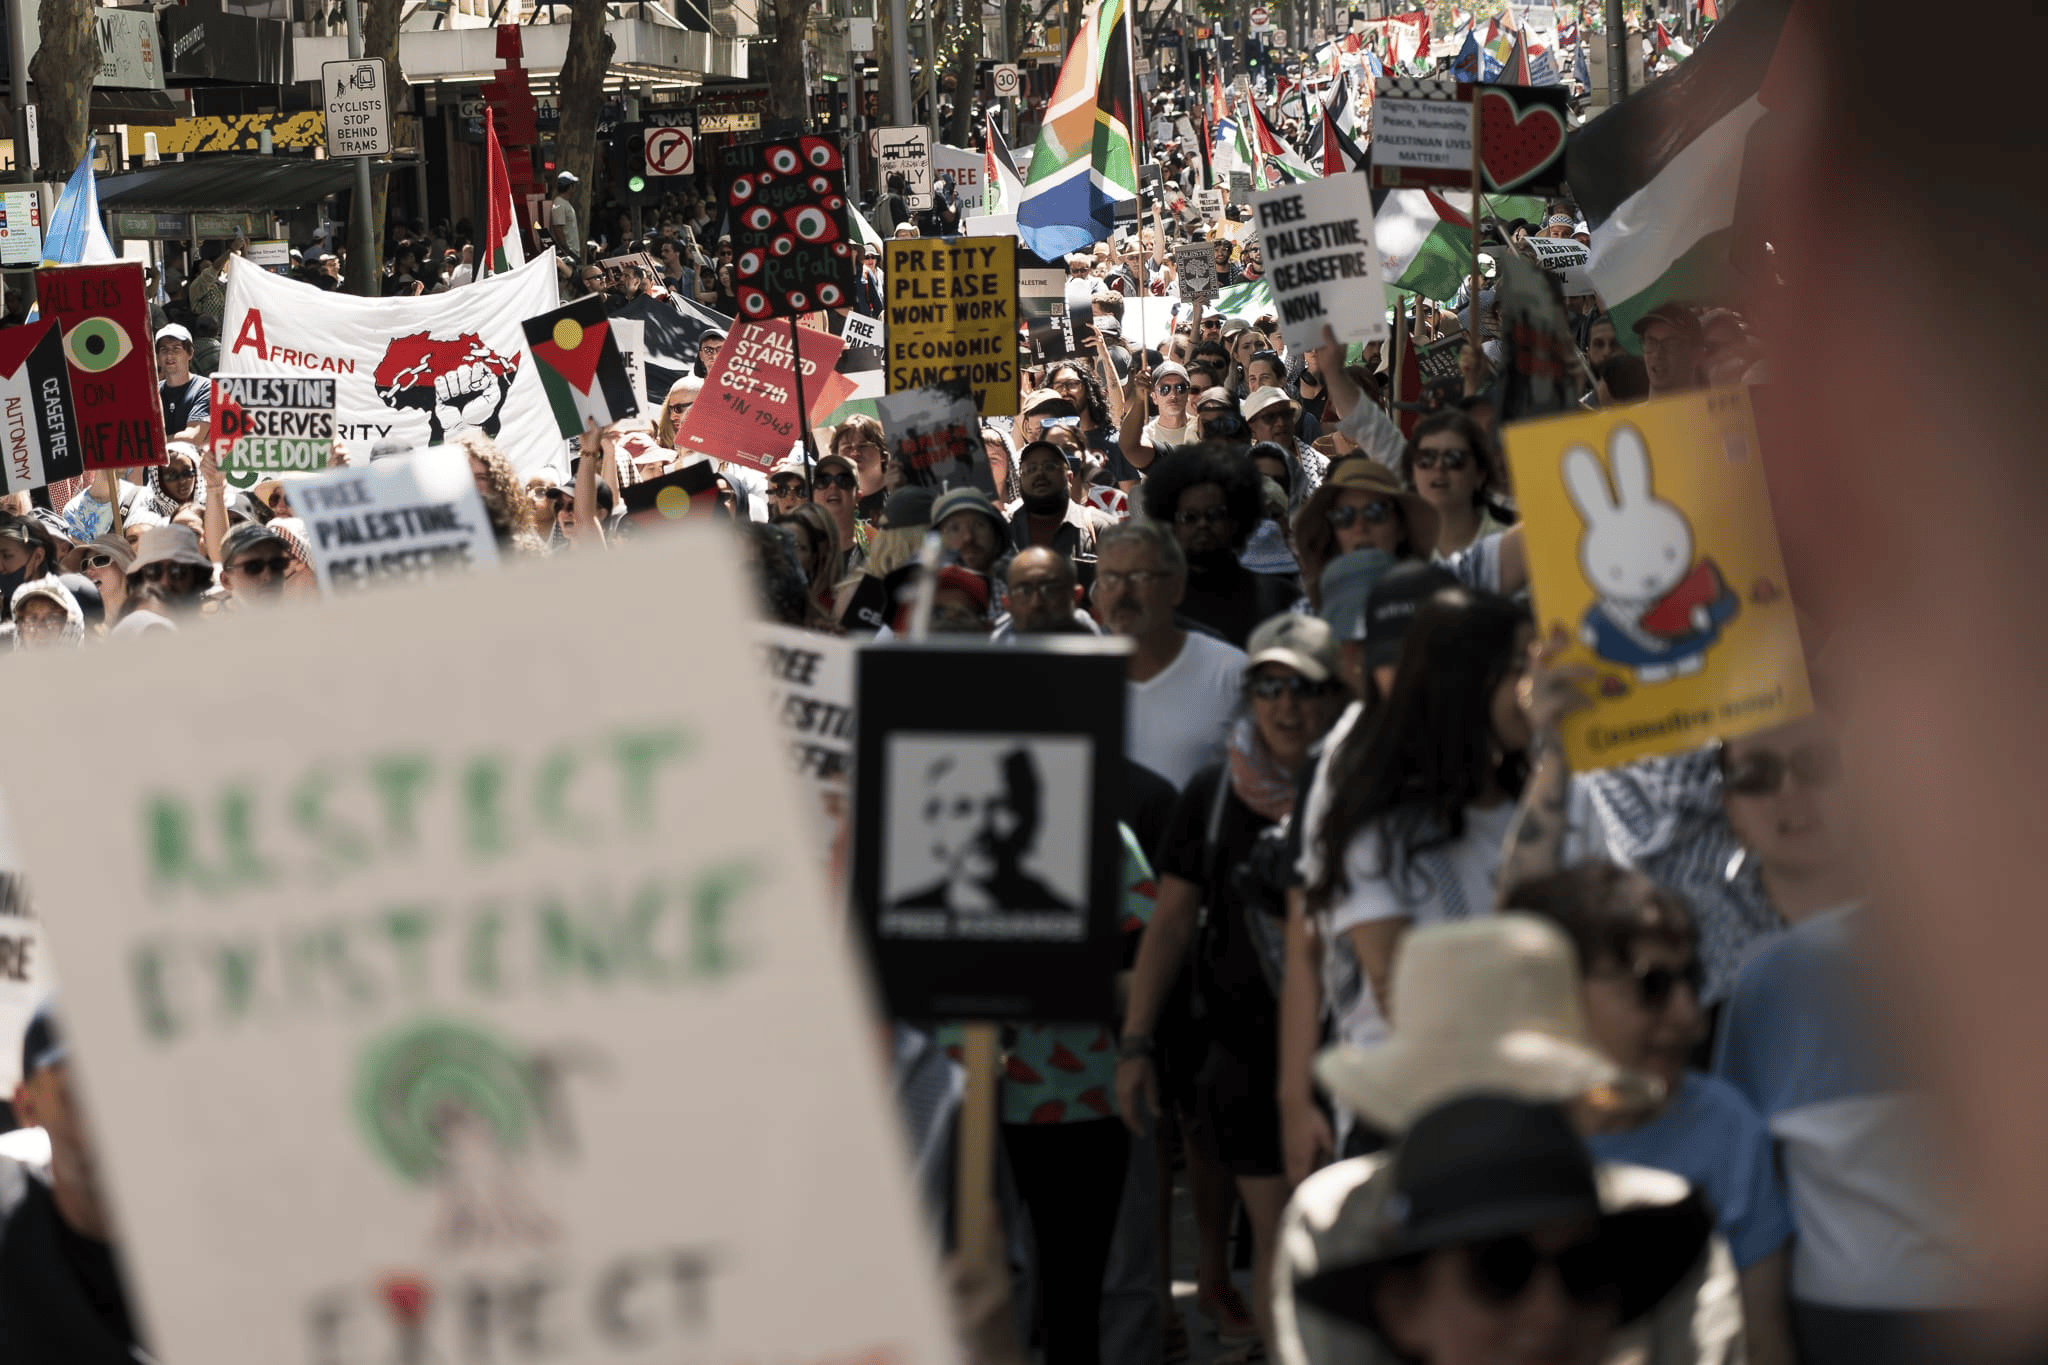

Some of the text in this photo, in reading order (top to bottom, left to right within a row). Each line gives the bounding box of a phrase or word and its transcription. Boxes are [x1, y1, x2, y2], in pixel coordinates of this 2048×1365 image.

[998, 74, 1014, 86] 30
[330, 100, 382, 113] CYCLISTS
[343, 114, 370, 125] STOP
[337, 127, 378, 139] BEHIND
[340, 140, 378, 152] TRAMS
[1377, 134, 1471, 149] PALESTINIAN LIVES
[1259, 195, 1306, 228] FREE
[1266, 219, 1368, 260] PALESTINE,
[763, 246, 839, 293] Rafah
[895, 246, 996, 272] PRETTY
[1274, 252, 1367, 292] CEASEFIRE
[1543, 253, 1588, 269] CEASEFIRE
[43, 279, 120, 314] ALL EYES
[896, 273, 998, 299] PLEASE
[892, 299, 1006, 324] WON'T WORK
[1281, 291, 1327, 325] NOW.
[232, 307, 355, 374] AFRICAN
[743, 324, 794, 353] IT ALL
[846, 334, 878, 348] PALE
[849, 319, 874, 338] FREE
[735, 340, 817, 376] STARTED
[895, 335, 1002, 360] ECONOMIC
[728, 356, 757, 375] ON
[894, 360, 1012, 390] SANCTIONS
[83, 383, 114, 407] ON
[217, 378, 333, 408] PALESTINE
[720, 371, 760, 394] OCT
[42, 377, 67, 460] CEASEFIRE
[221, 409, 333, 438] DESERVES
[338, 424, 392, 440] RITY
[756, 409, 794, 436] 1948
[4, 397, 31, 480] AUTONOMY
[83, 419, 154, 463] AFAH
[215, 438, 333, 469] FREEDOM
[302, 479, 375, 514] FREE
[316, 503, 475, 549] PALESTINE,
[770, 645, 825, 686] REE
